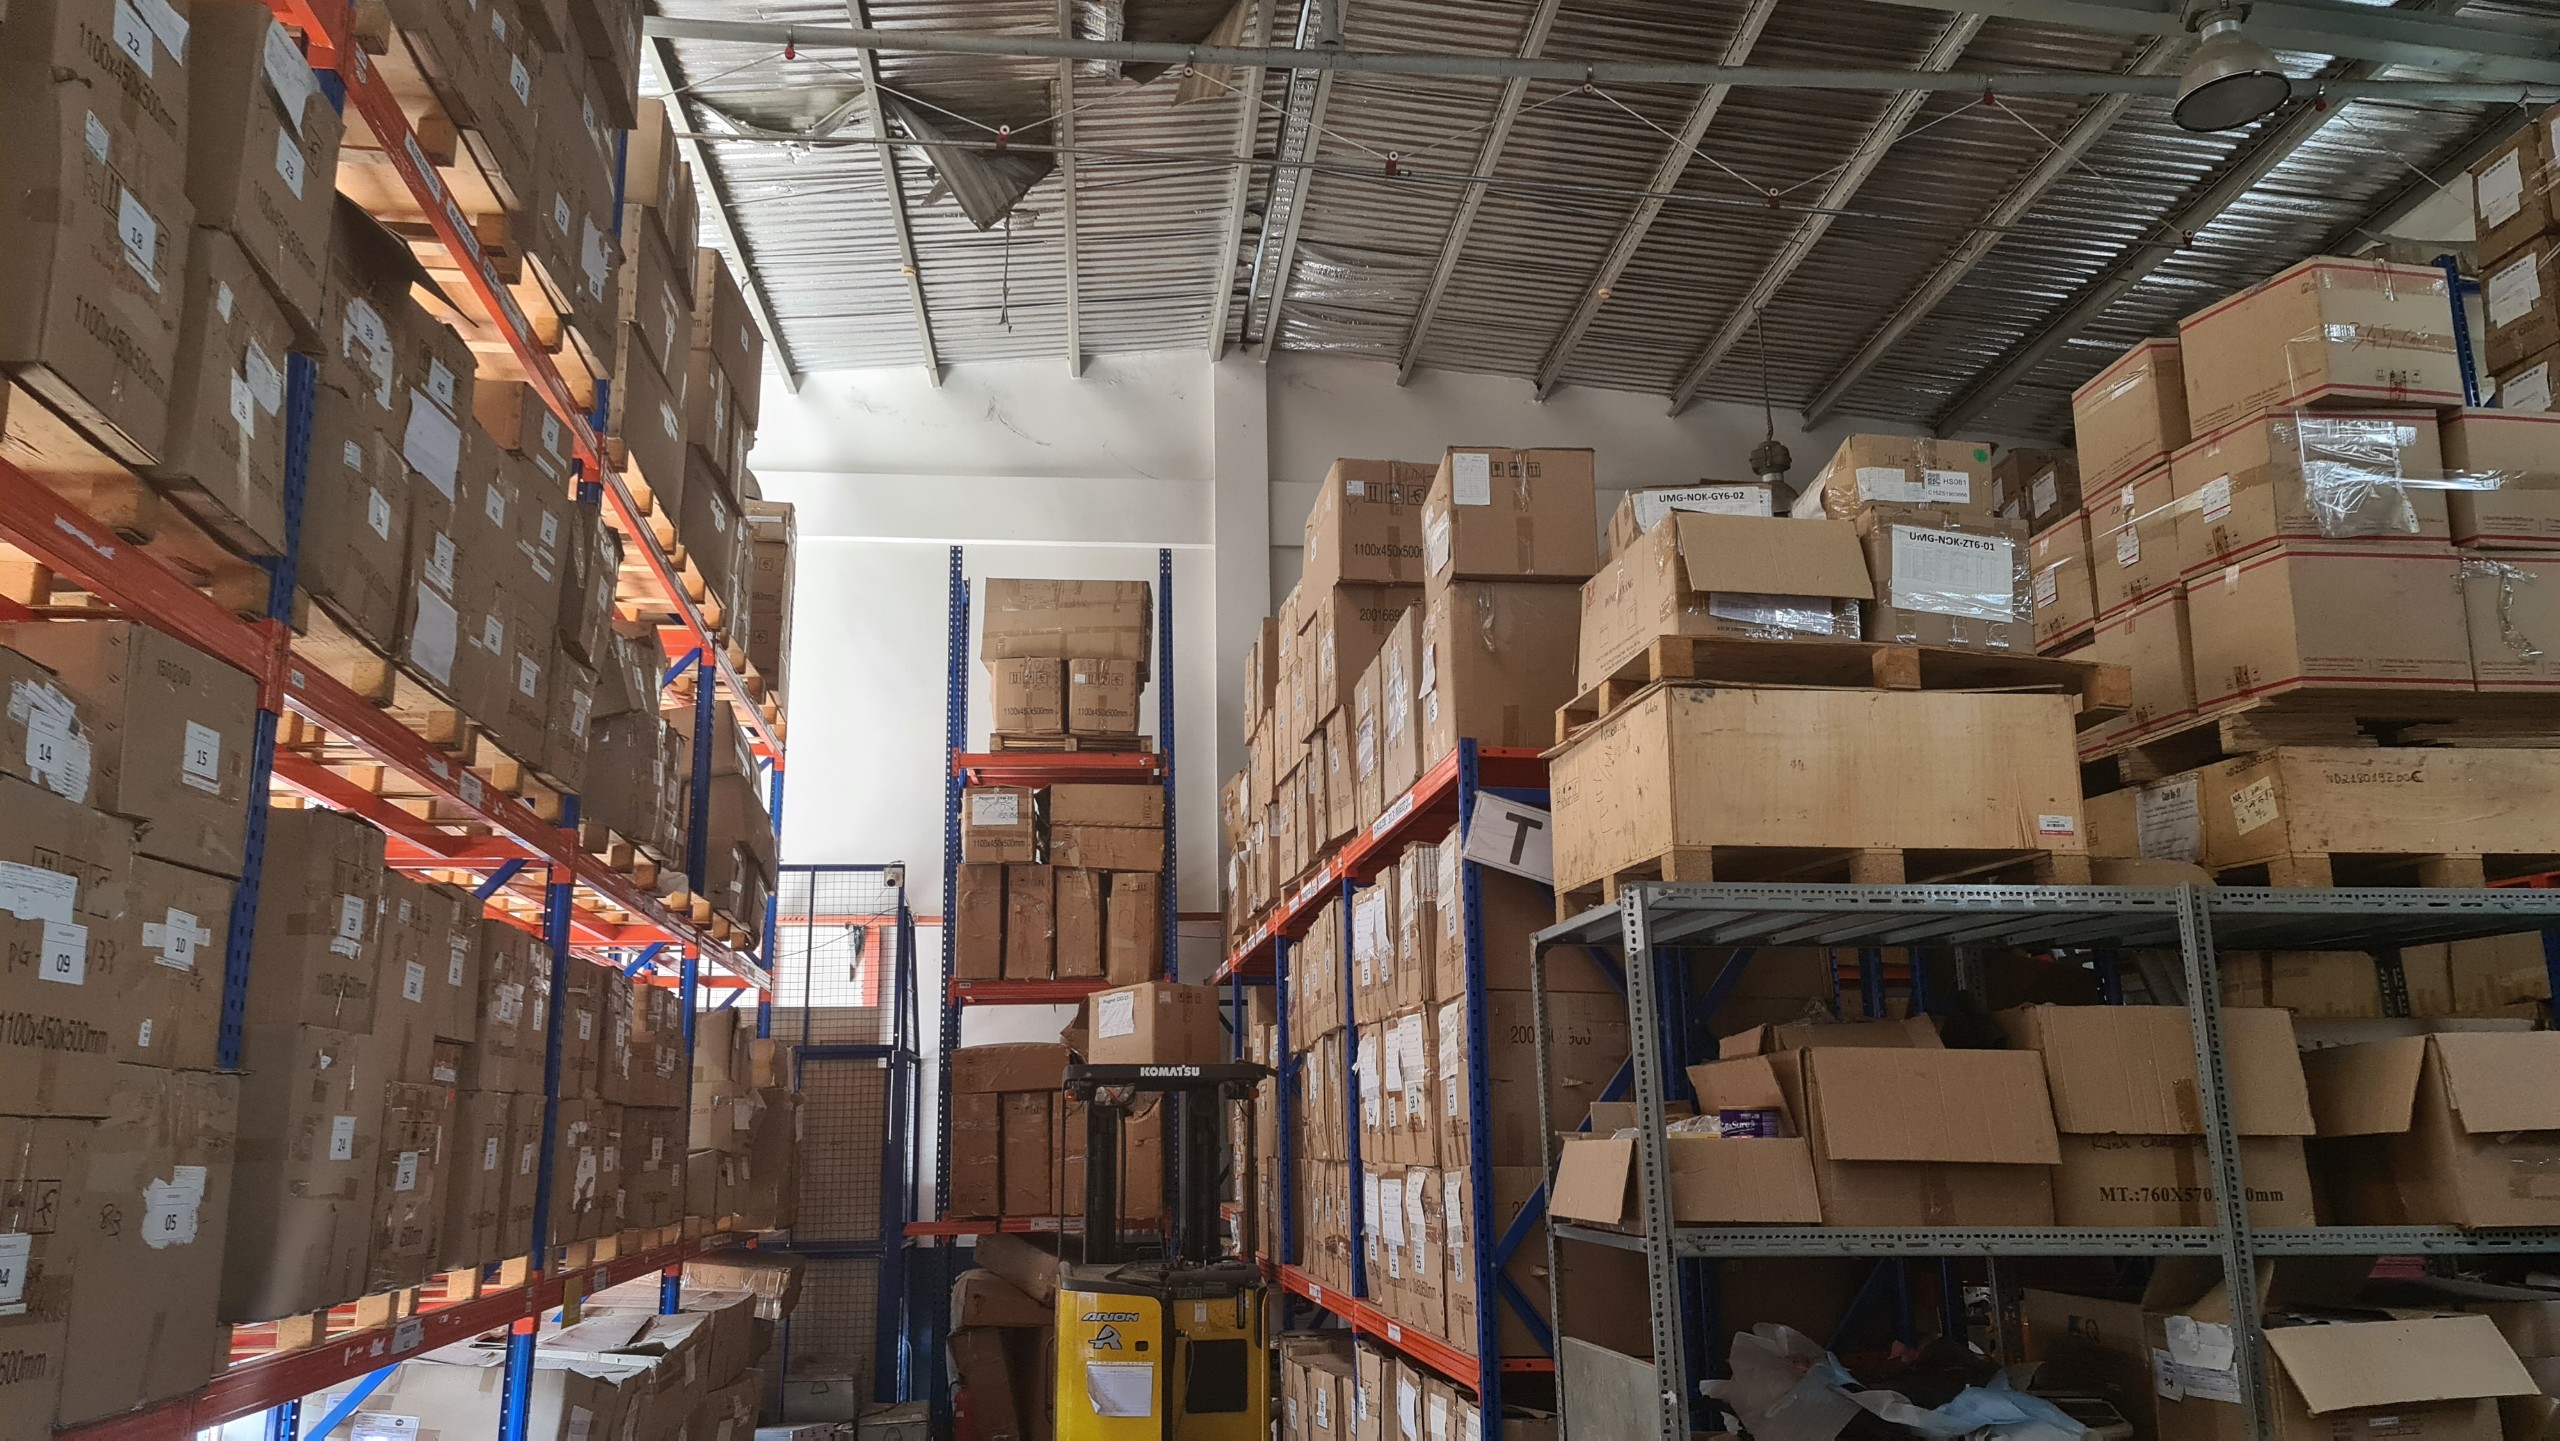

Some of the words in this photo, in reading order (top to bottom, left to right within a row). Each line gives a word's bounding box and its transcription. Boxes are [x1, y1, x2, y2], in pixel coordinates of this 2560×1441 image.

[126, 31, 141, 58] 22
[1659, 491, 1745, 504] UMG-NOK-GY6-02
[1908, 531, 1996, 552] UMG-NOK-ZT6-01
[39, 742, 53, 764] 14
[197, 749, 208, 767] 15
[1505, 811, 1544, 866] T
[175, 935, 187, 954] 10
[56, 953, 71, 973] 09
[1139, 1064, 1201, 1077] KOMATSU
[164, 1213, 178, 1232] 05
[1081, 1311, 1140, 1323] ARION
